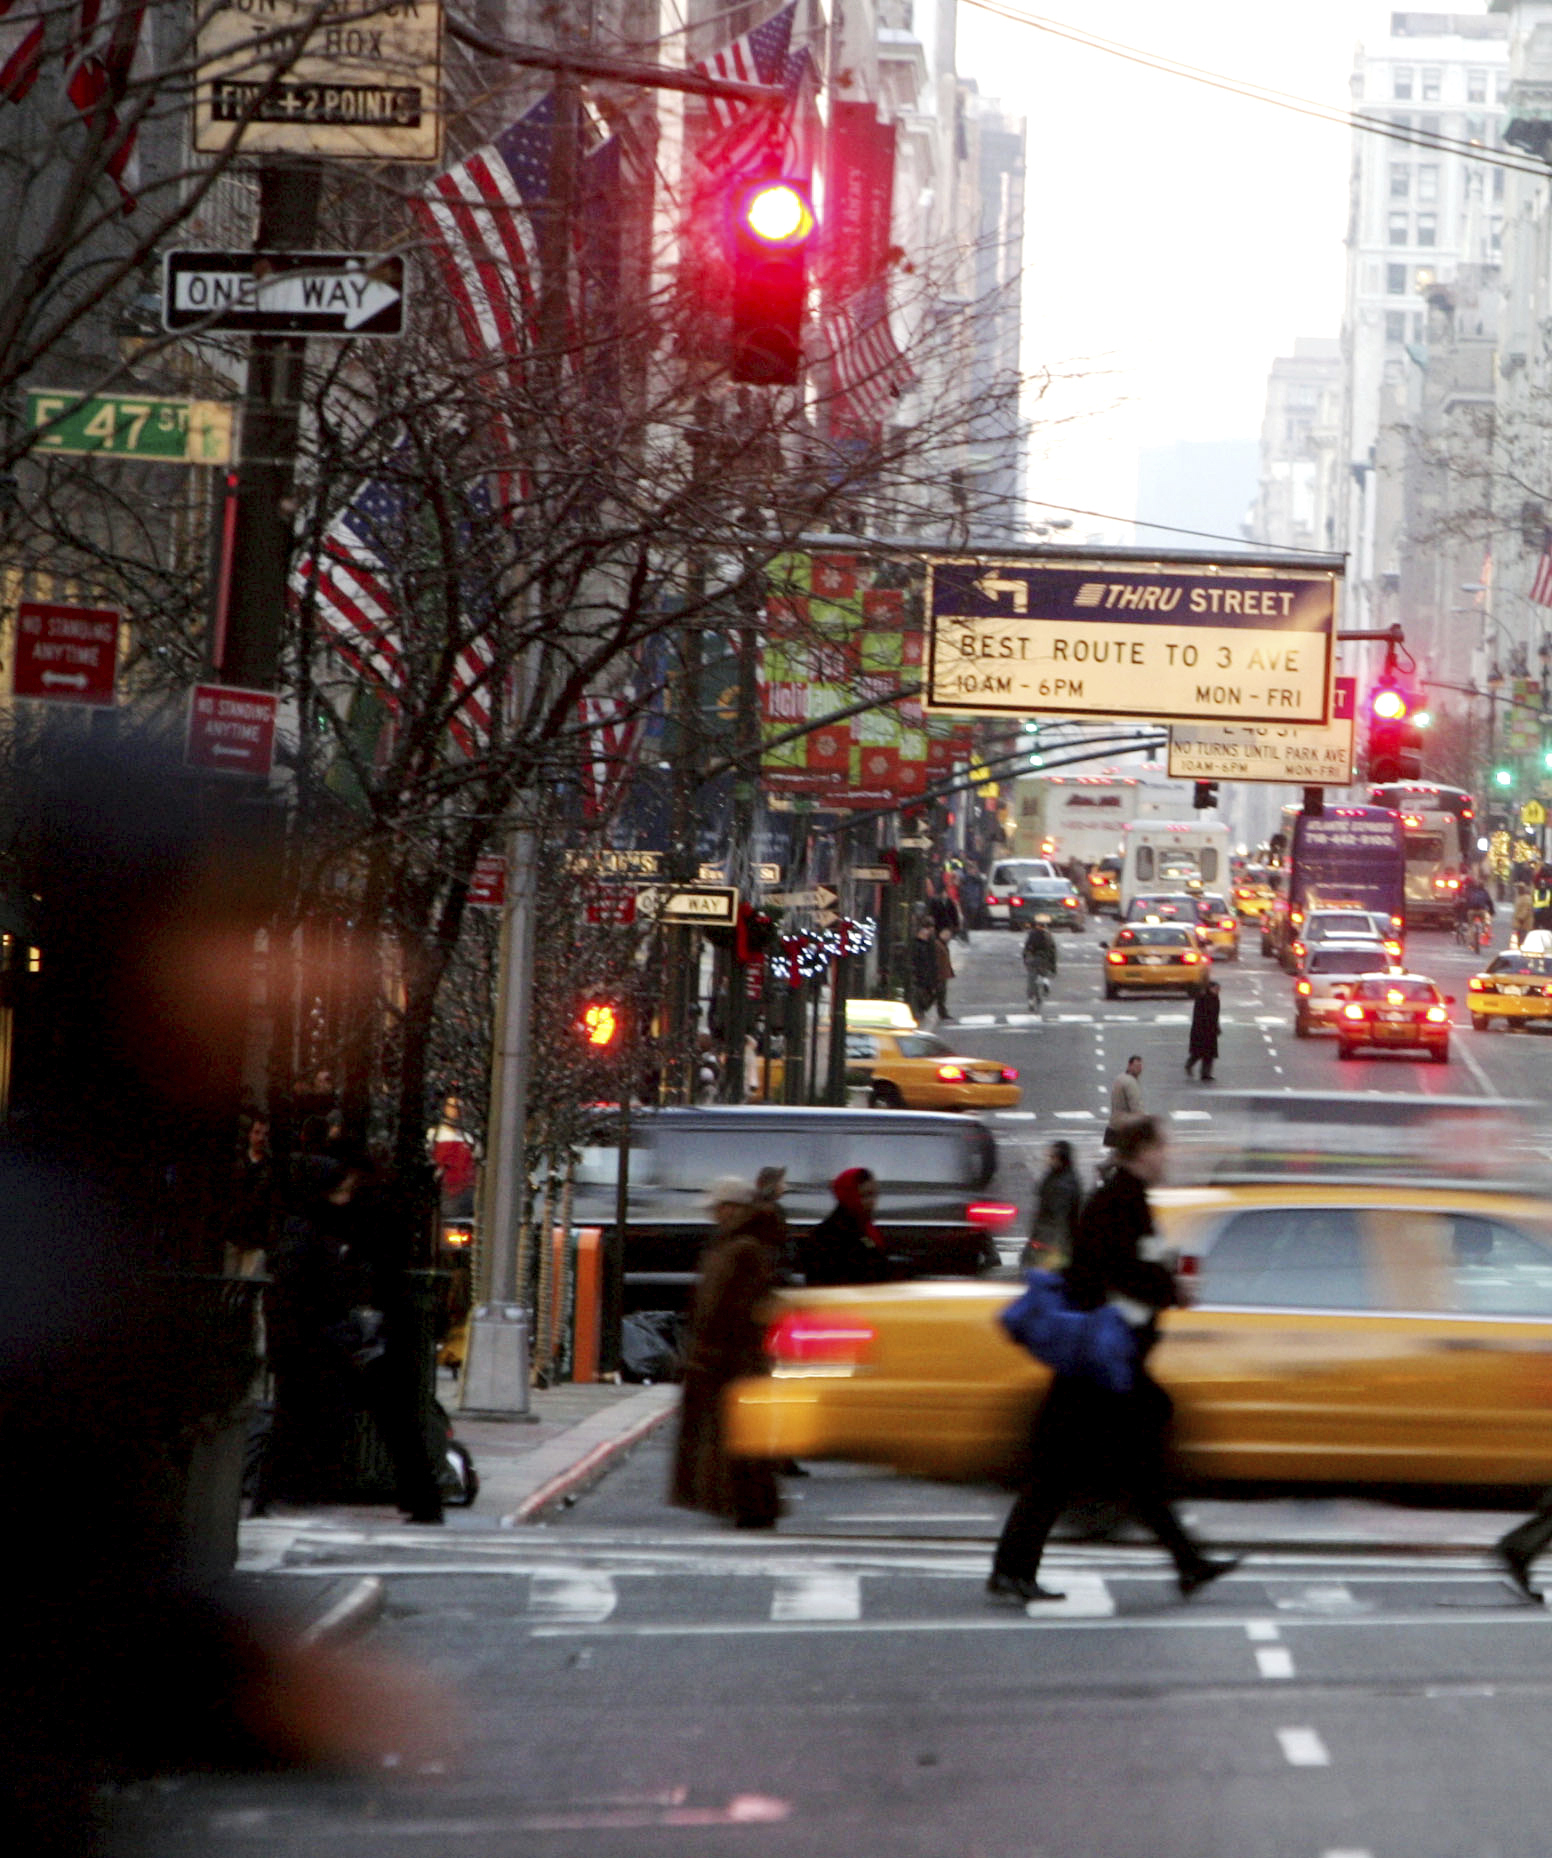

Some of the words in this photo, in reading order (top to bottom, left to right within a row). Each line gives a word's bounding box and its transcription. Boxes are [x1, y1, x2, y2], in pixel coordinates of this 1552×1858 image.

[326, 27, 384, 58] BOX
[187, 276, 258, 308] ONE
[301, 277, 370, 309] WAY
[35, 399, 65, 445] E
[82, 404, 150, 451] 47
[157, 407, 189, 433] ST
[1103, 583, 1182, 612] THRU
[1189, 589, 1296, 618] STREET
[959, 634, 1031, 661] BEST
[1053, 638, 1145, 666] ROUTE
[1165, 643, 1199, 668] TO
[1216, 646, 1232, 668] 3
[1248, 647, 1300, 673] AVE
[956, 675, 1013, 695] 10AM
[1038, 678, 1085, 698] 6PM
[1195, 686, 1242, 704] MON
[1267, 688, 1301, 708] FRI
[198, 698, 214, 716] NO
[217, 700, 273, 723] STANDING
[204, 720, 262, 743] ANYTIME
[1174, 740, 1193, 754] NO
[1198, 742, 1239, 758] TURNS
[1244, 744, 1281, 760] UNTIL
[1285, 746, 1319, 762] PARK
[1324, 747, 1347, 763] AVE
[688, 895, 721, 912] WAY
